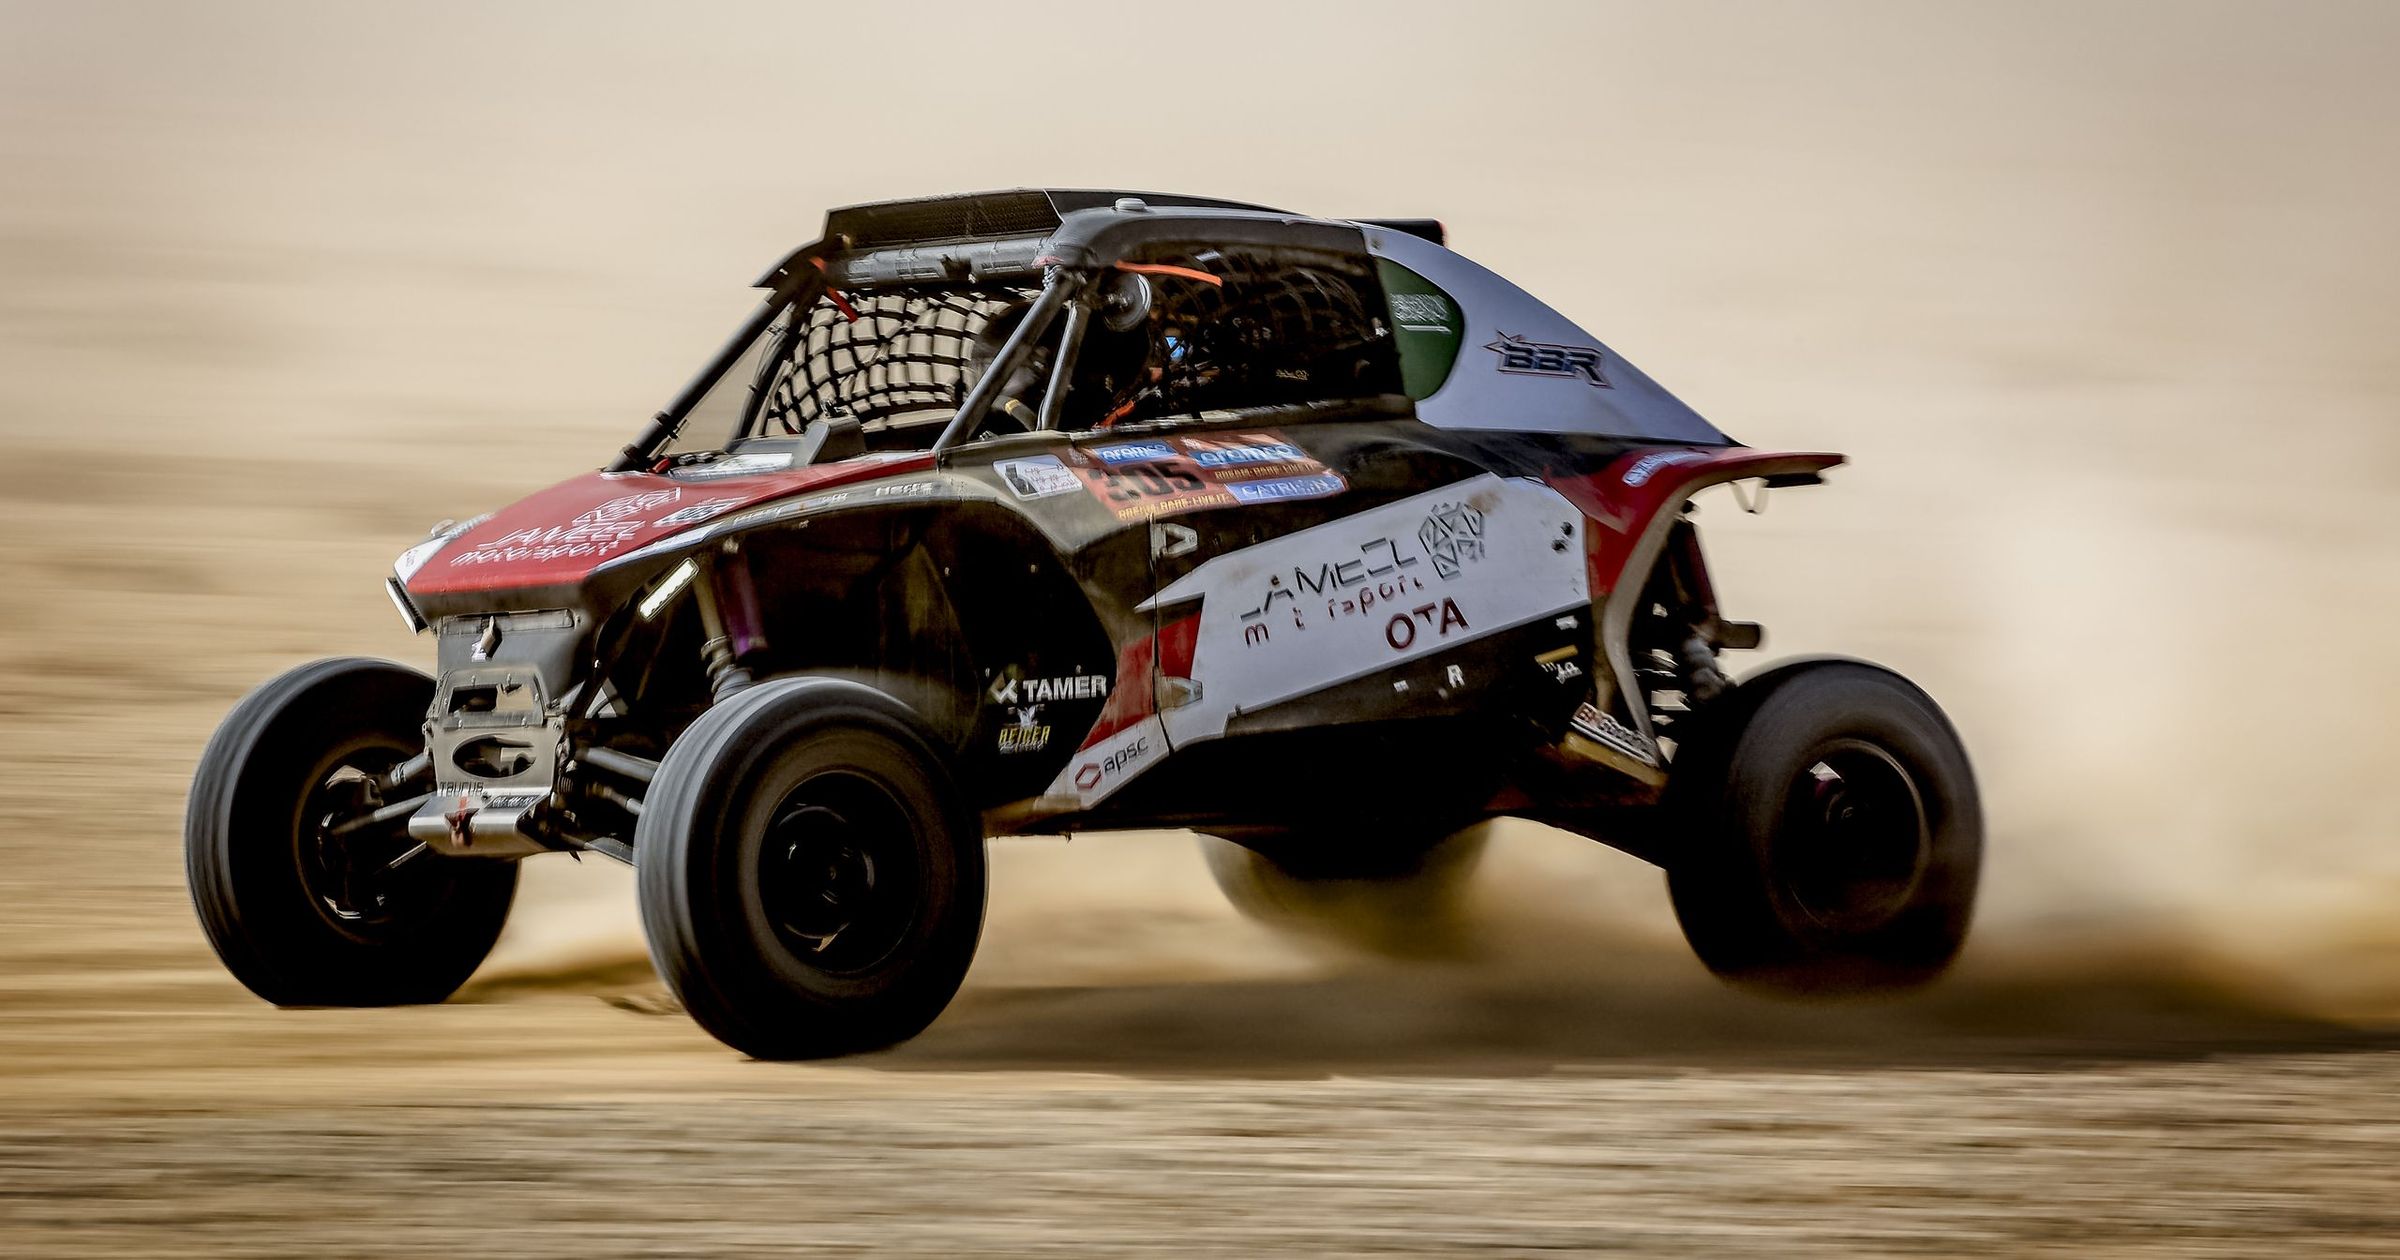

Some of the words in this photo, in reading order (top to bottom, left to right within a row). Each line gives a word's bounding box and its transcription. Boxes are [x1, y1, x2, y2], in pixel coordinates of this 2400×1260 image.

[1498, 336, 1611, 389] BBR
[1102, 443, 1167, 460] aramco
[1200, 445, 1290, 466] aramco
[477, 520, 647, 550] JAMEEL
[1023, 675, 1107, 702] TAMER
[1103, 736, 1148, 774] apsc
